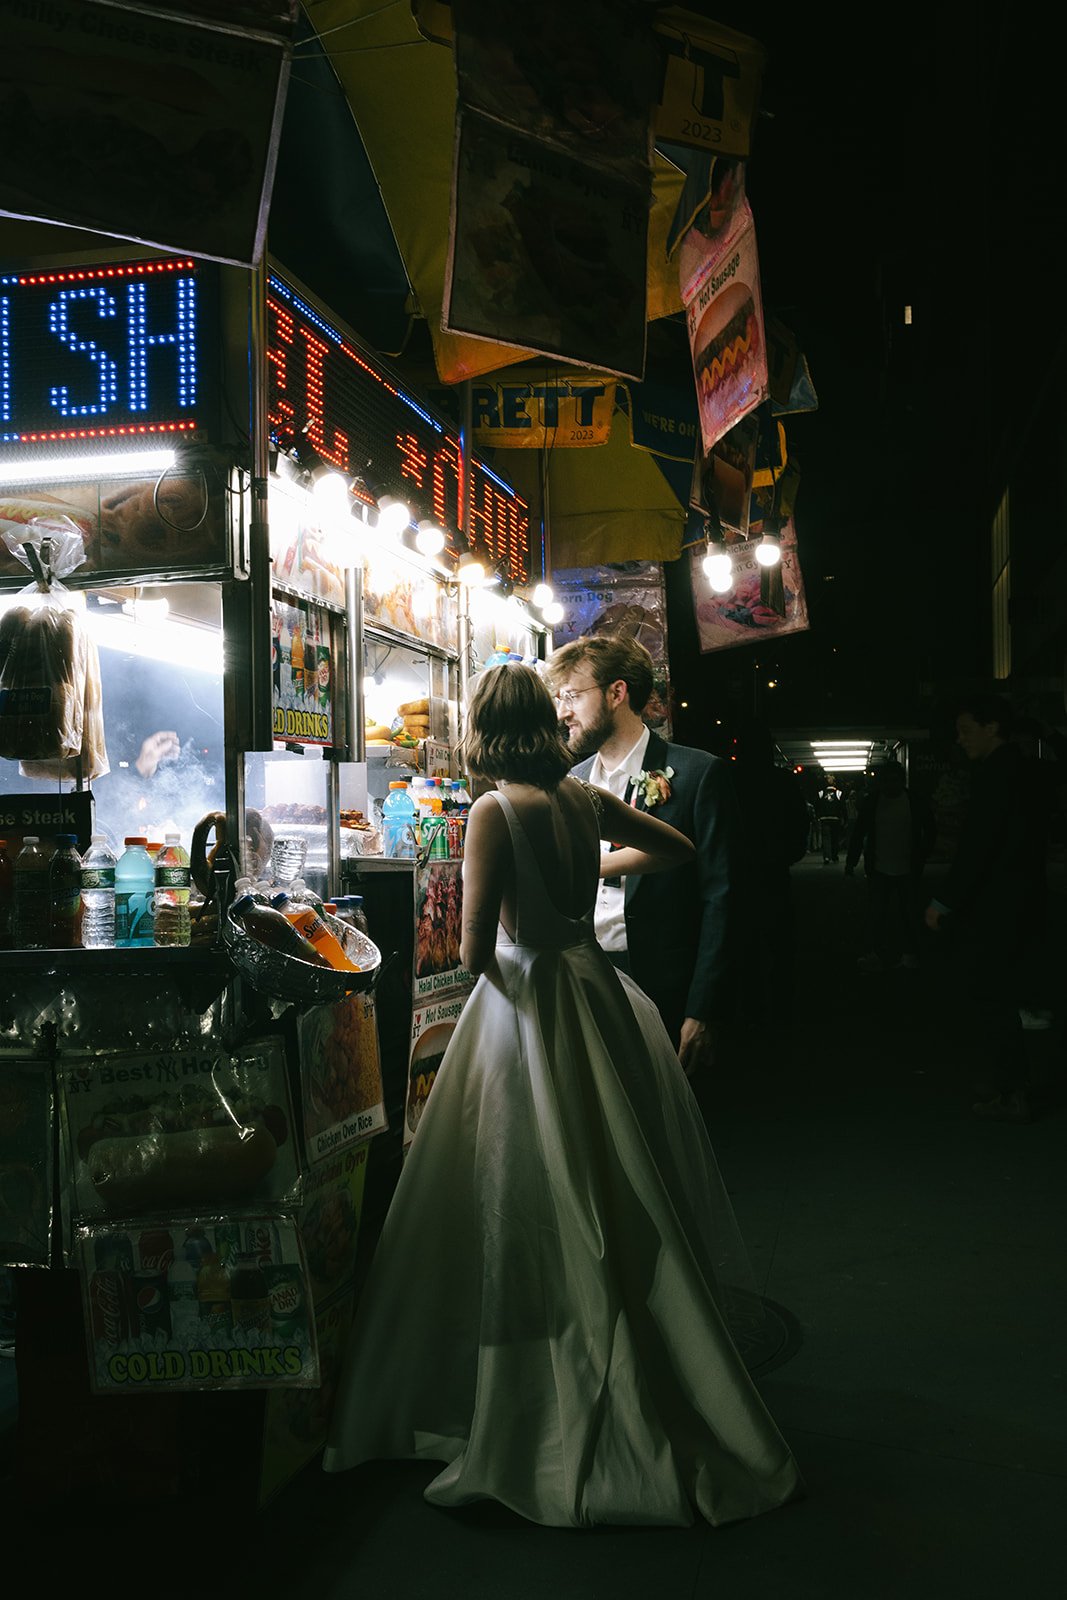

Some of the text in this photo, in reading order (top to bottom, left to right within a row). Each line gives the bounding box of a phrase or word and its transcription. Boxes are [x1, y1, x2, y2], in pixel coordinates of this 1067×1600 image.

[80, 11, 178, 53] Cheese
[187, 36, 265, 73] Steak
[681, 119, 722, 143] 2023
[699, 252, 741, 311] Hot Sausage
[570, 429, 595, 442] 2023
[586, 590, 613, 603] Dog
[286, 709, 329, 739] DRINKS
[21, 808, 77, 827] Steak
[418, 977, 433, 994] Halal
[433, 974, 453, 990] Chicken
[425, 1002, 462, 1024] Hot Sausage
[100, 1064, 154, 1085] Best
[181, 1056, 222, 1075] Hot
[316, 1114, 373, 1153] Chicken Over Rice
[345, 1148, 366, 1174] Gyro
[277, 1297, 298, 1311] DRY
[108, 1346, 303, 1383] COLD DRINKS
